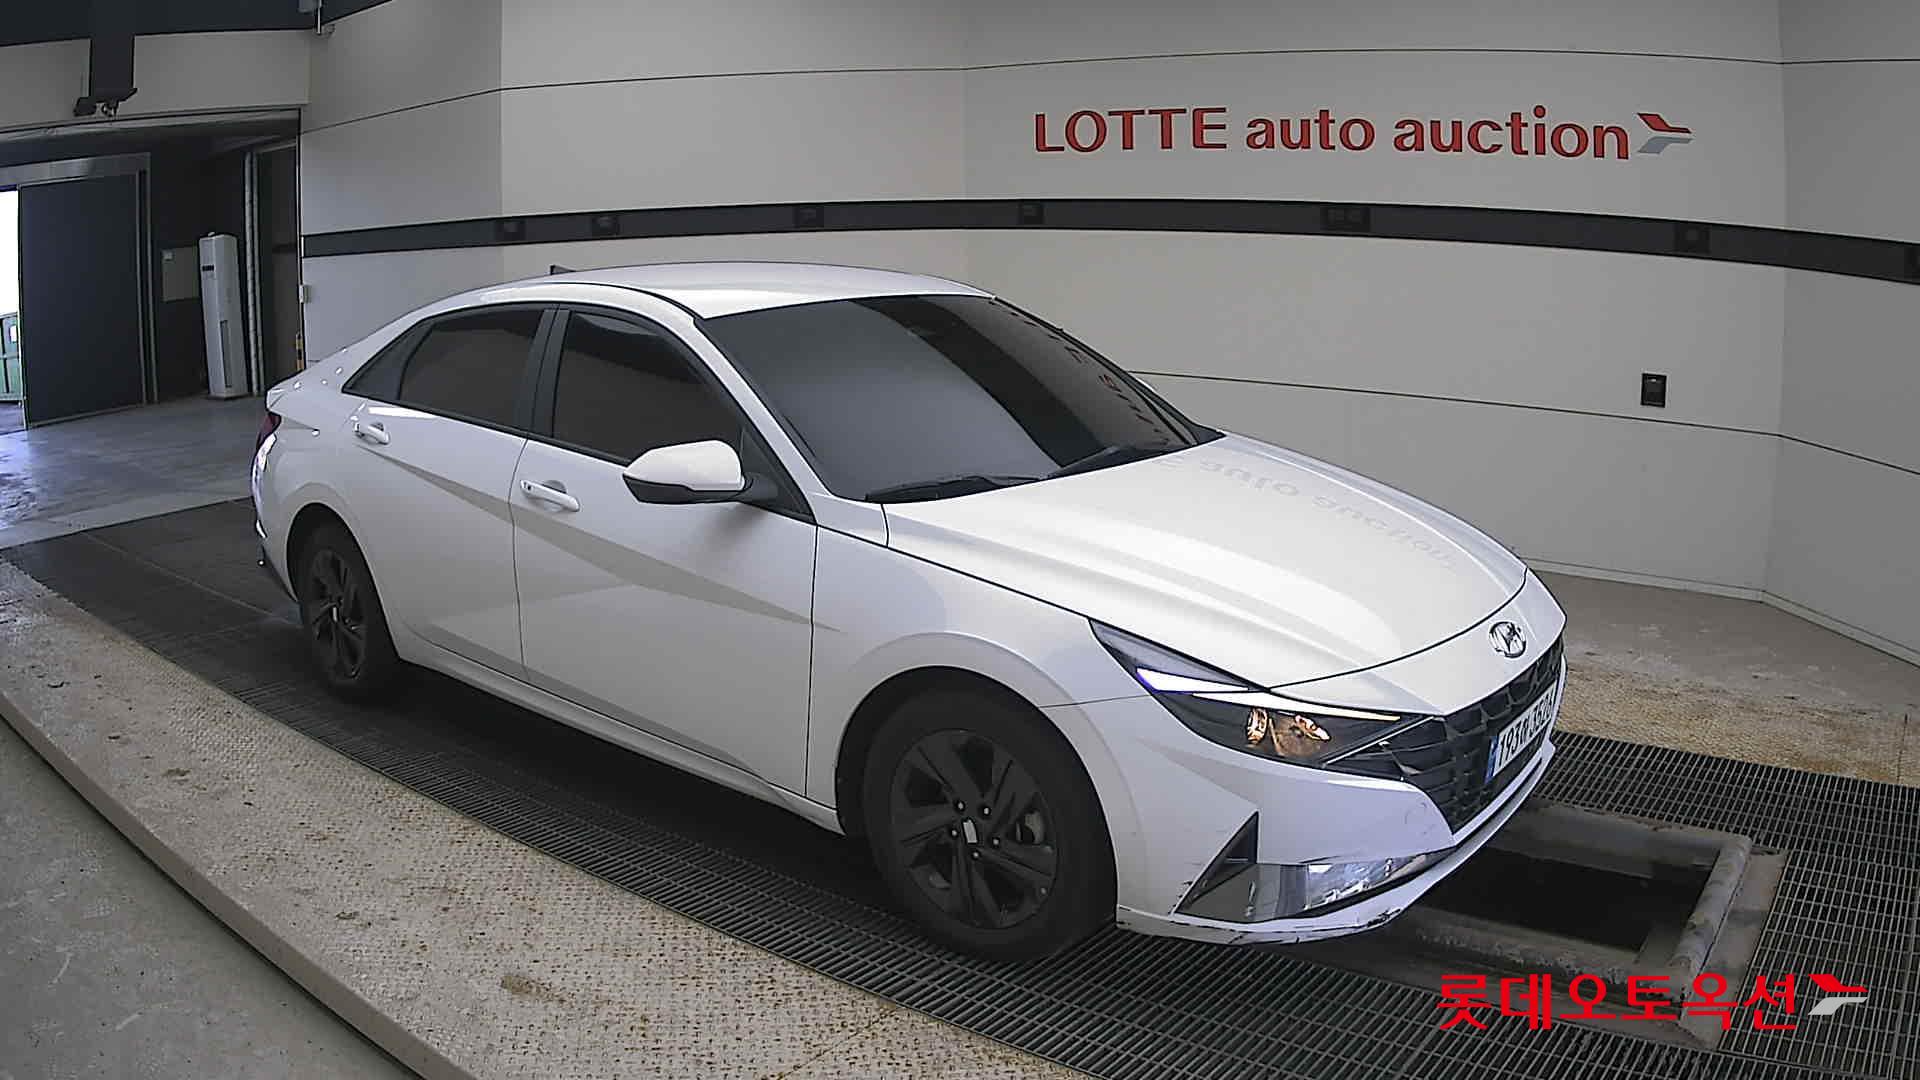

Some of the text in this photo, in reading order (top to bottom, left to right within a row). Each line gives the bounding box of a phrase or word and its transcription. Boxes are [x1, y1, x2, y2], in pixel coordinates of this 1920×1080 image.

[1035, 105, 1629, 160] LOTTE auto auction
